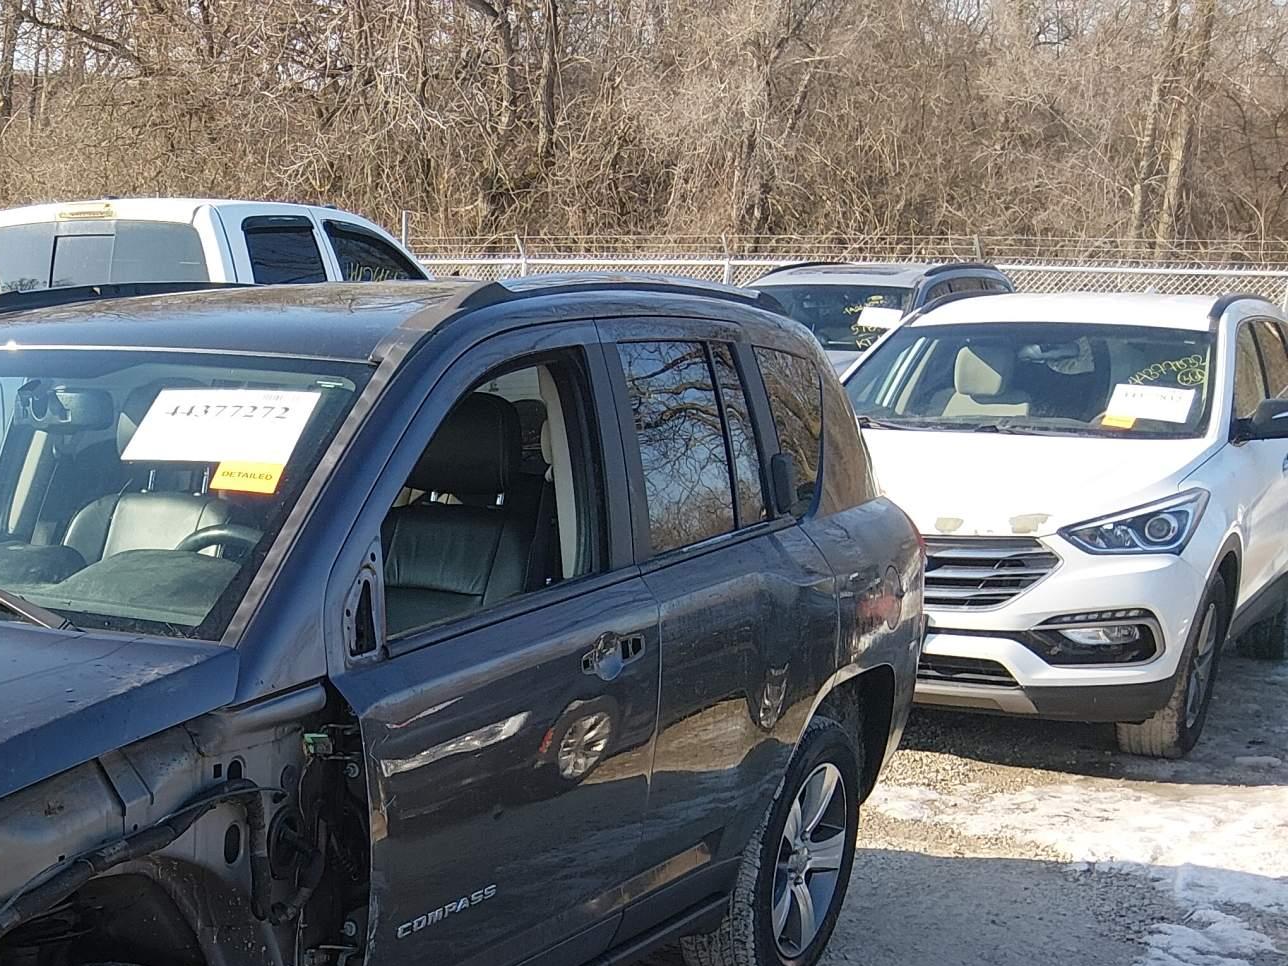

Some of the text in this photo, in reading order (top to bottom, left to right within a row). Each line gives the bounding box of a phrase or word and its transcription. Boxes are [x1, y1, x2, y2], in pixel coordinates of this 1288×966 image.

[164, 404, 291, 420] 44377272
[220, 470, 274, 482] DETAILED
[396, 884, 497, 939] COMPASS
